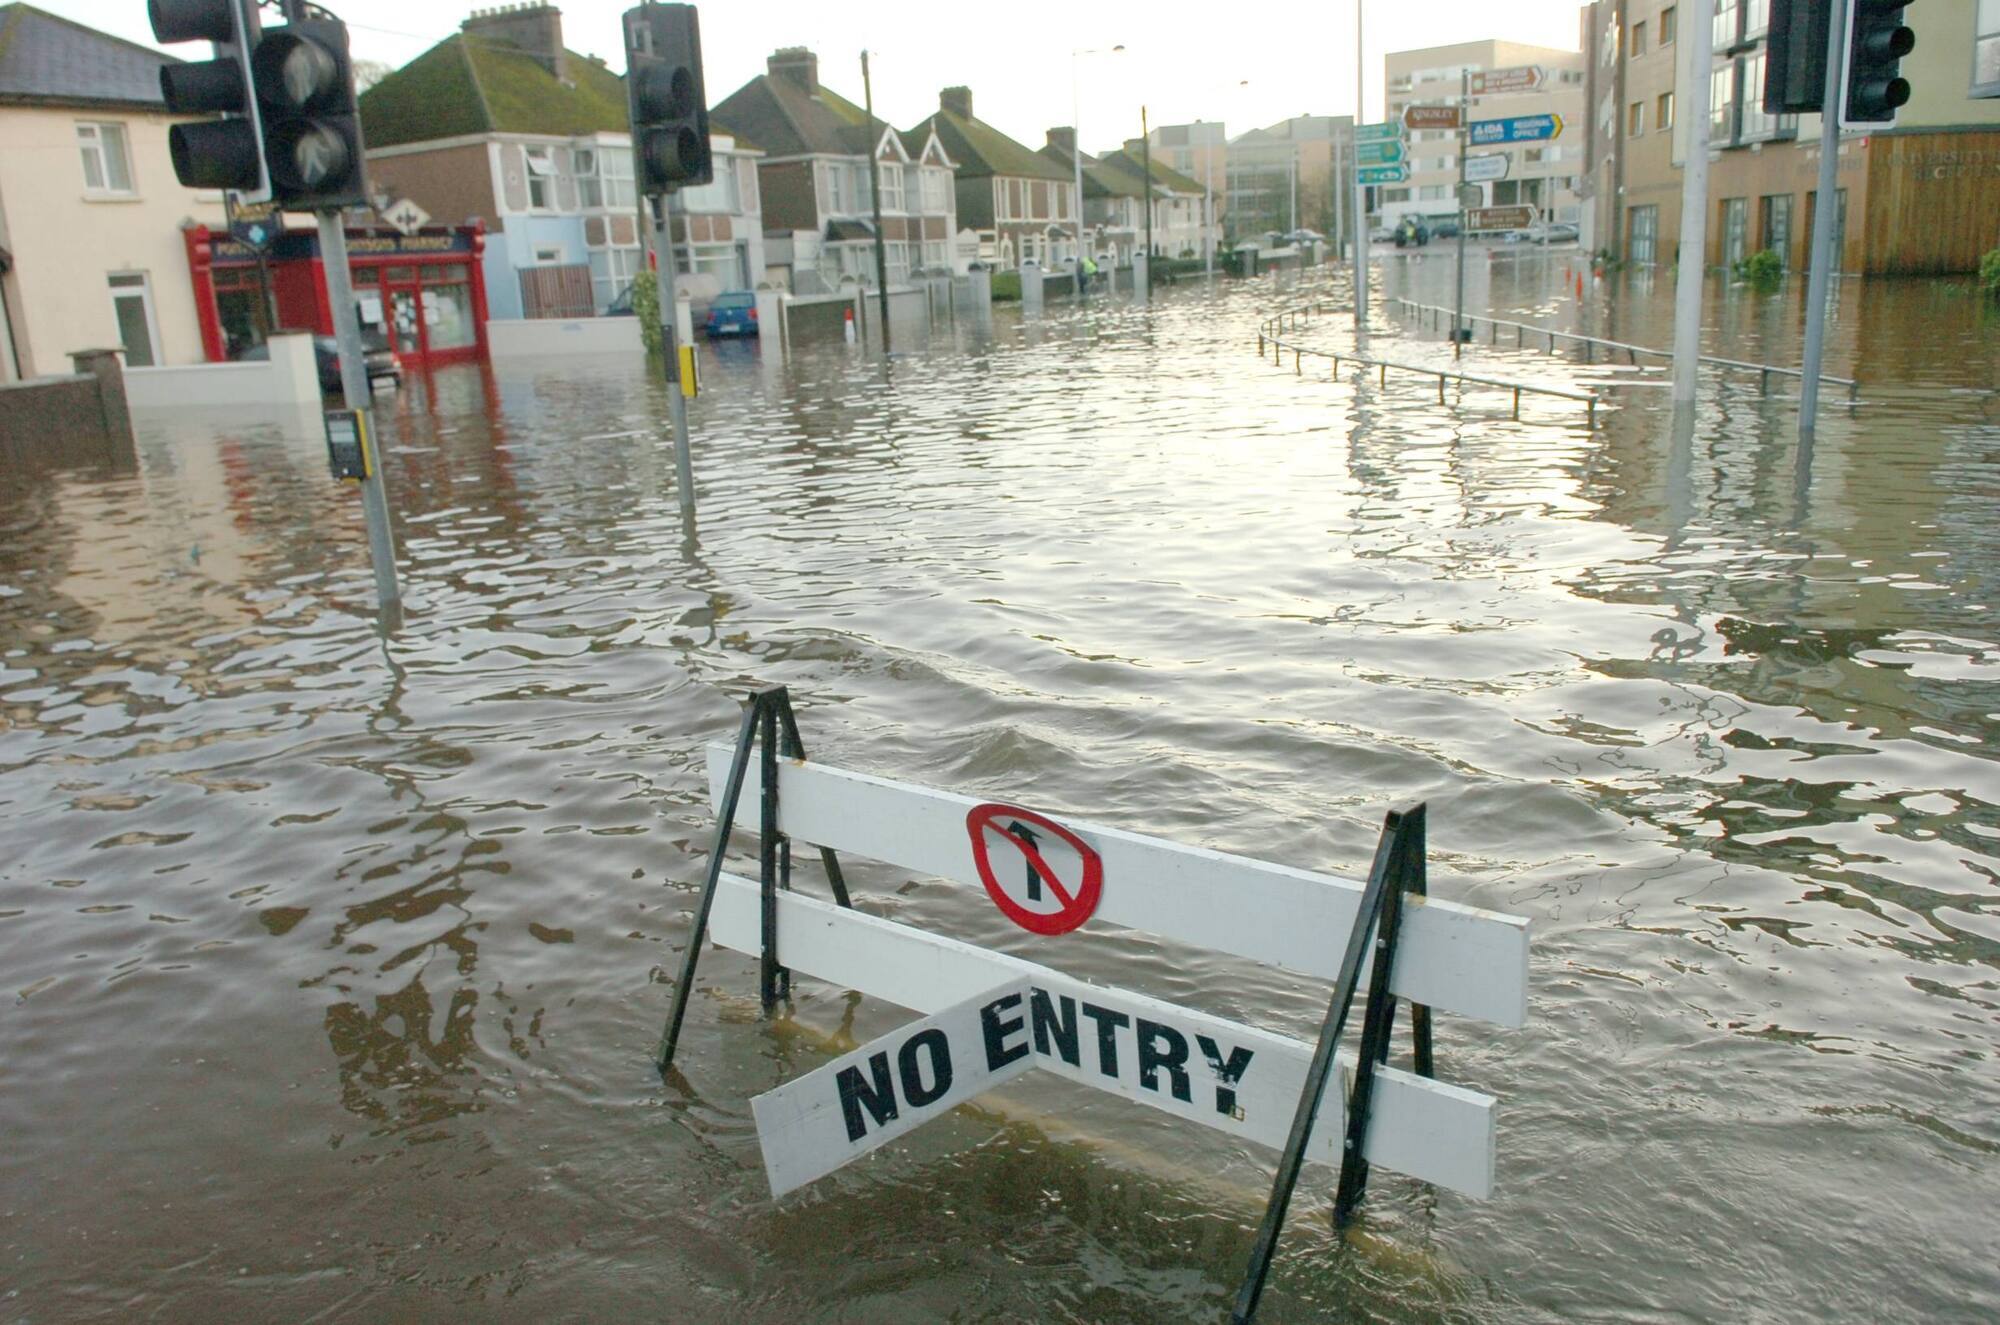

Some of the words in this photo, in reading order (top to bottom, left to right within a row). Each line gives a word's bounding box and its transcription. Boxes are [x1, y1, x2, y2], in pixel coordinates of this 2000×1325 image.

[1412, 109, 1453, 120] KINGSLEY
[1513, 118, 1551, 128] REGIONAL
[1513, 128, 1540, 138] OFFICE
[836, 1029, 953, 1143] NO
[980, 986, 1255, 1117] ENTRY
